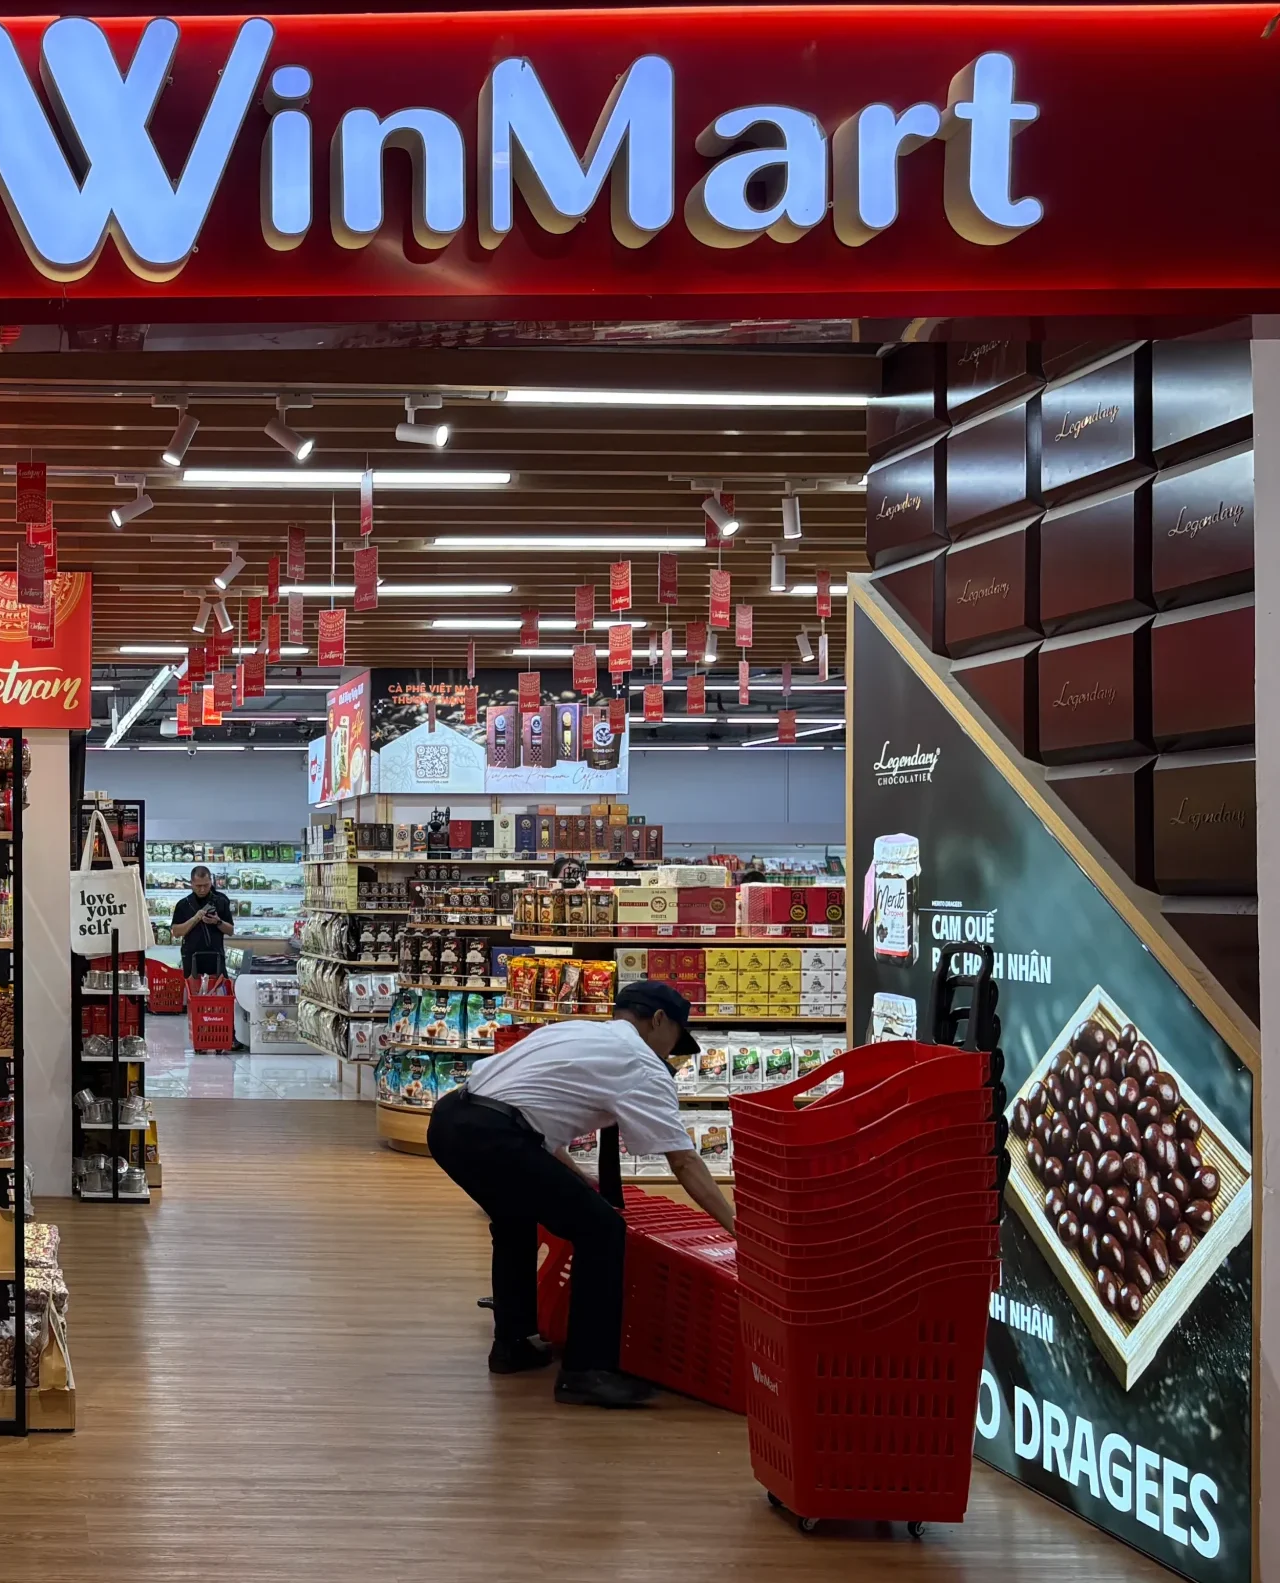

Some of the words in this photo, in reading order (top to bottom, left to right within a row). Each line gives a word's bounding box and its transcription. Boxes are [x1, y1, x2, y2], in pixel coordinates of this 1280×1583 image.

[388, 683, 402, 693] CÀ
[406, 683, 426, 693] PHÊ
[429, 682, 452, 693] VIỆT
[874, 740, 939, 777] Legendary
[878, 772, 932, 786] CHOCOLATIER
[80, 890, 115, 906] love
[87, 903, 127, 921] your
[877, 884, 905, 915] Merito
[932, 914, 961, 940] CAM
[964, 908, 998, 944] QUẾ
[1008, 949, 1052, 984] NHÂN
[1009, 1299, 1054, 1344] NHÂN
[751, 1362, 780, 1397] WinMart
[1014, 1385, 1221, 1559] DRAGEES
